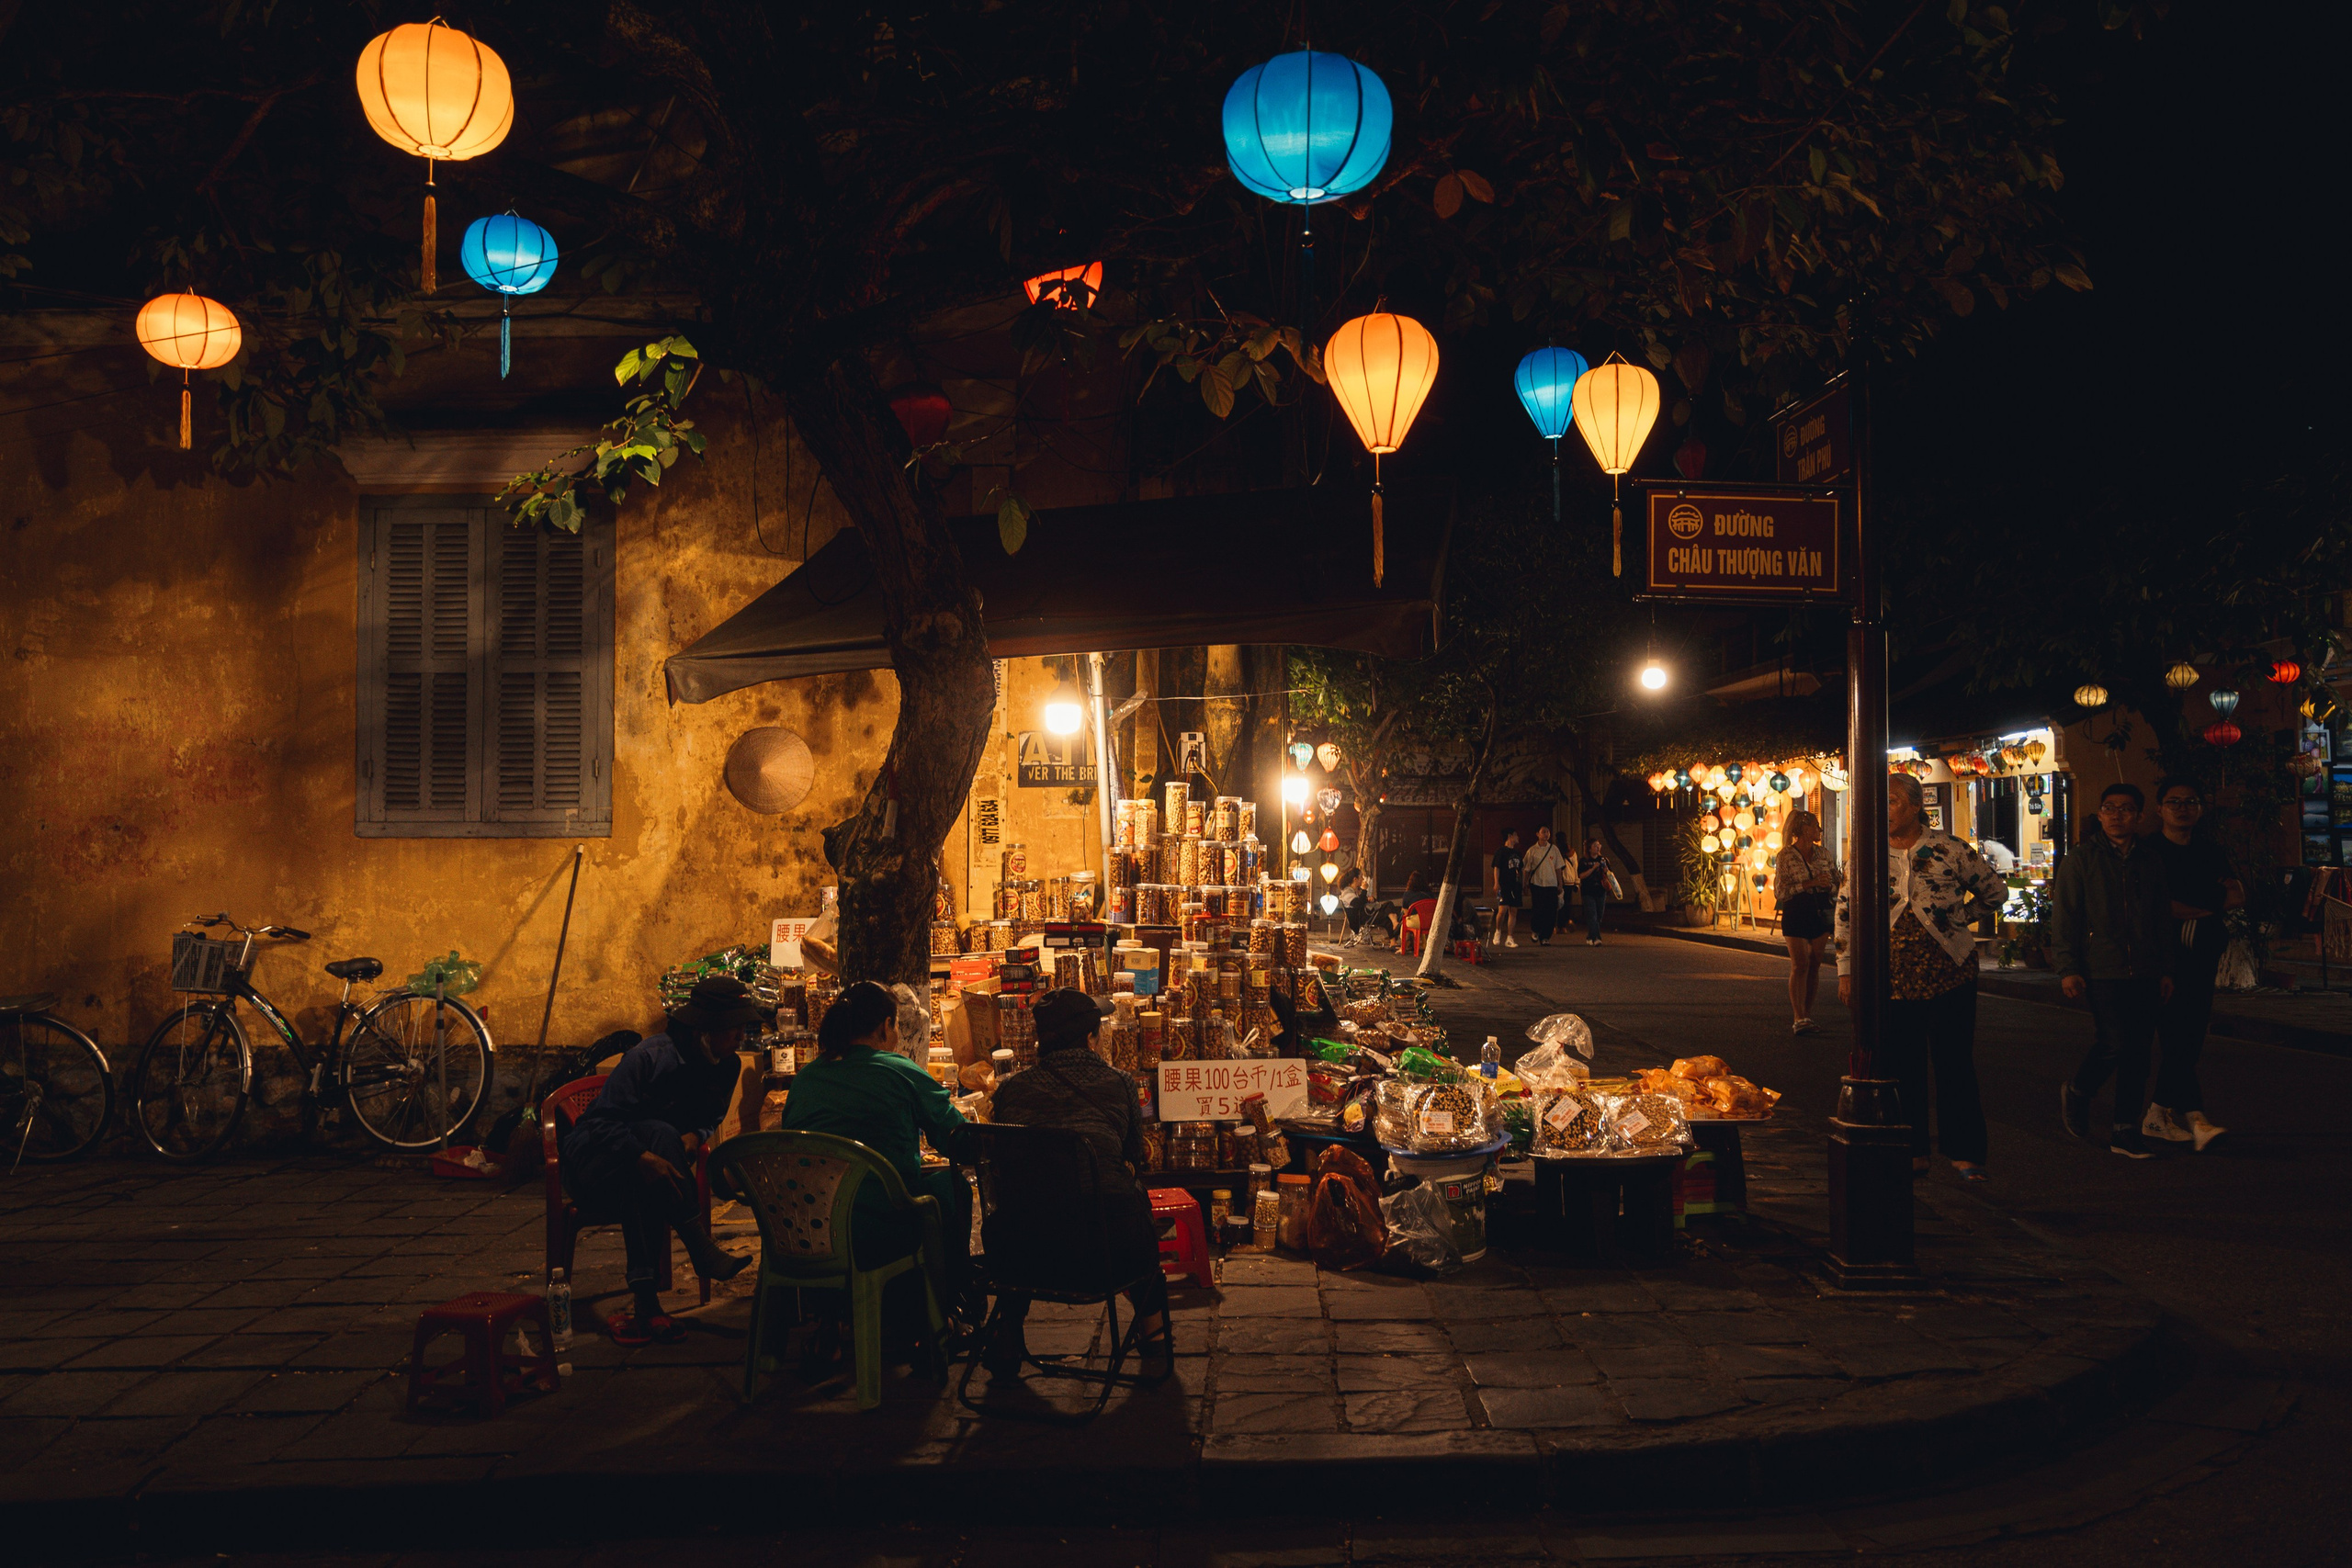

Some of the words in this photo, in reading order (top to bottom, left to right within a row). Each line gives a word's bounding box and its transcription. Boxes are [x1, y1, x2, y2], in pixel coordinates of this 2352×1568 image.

[1800, 414, 1826, 446] ĐƯỜNG
[1816, 439, 1832, 473] PHÚ
[1714, 509, 1774, 537] ĐƯỜNG
[1668, 544, 1713, 574] CHÂU
[1718, 547, 1782, 580] THƯỢNG
[1788, 547, 1822, 577] VĂN
[1054, 766, 1076, 781] THE
[980, 799, 1000, 844] 0977.624.634
[776, 924, 806, 943] 腰果
